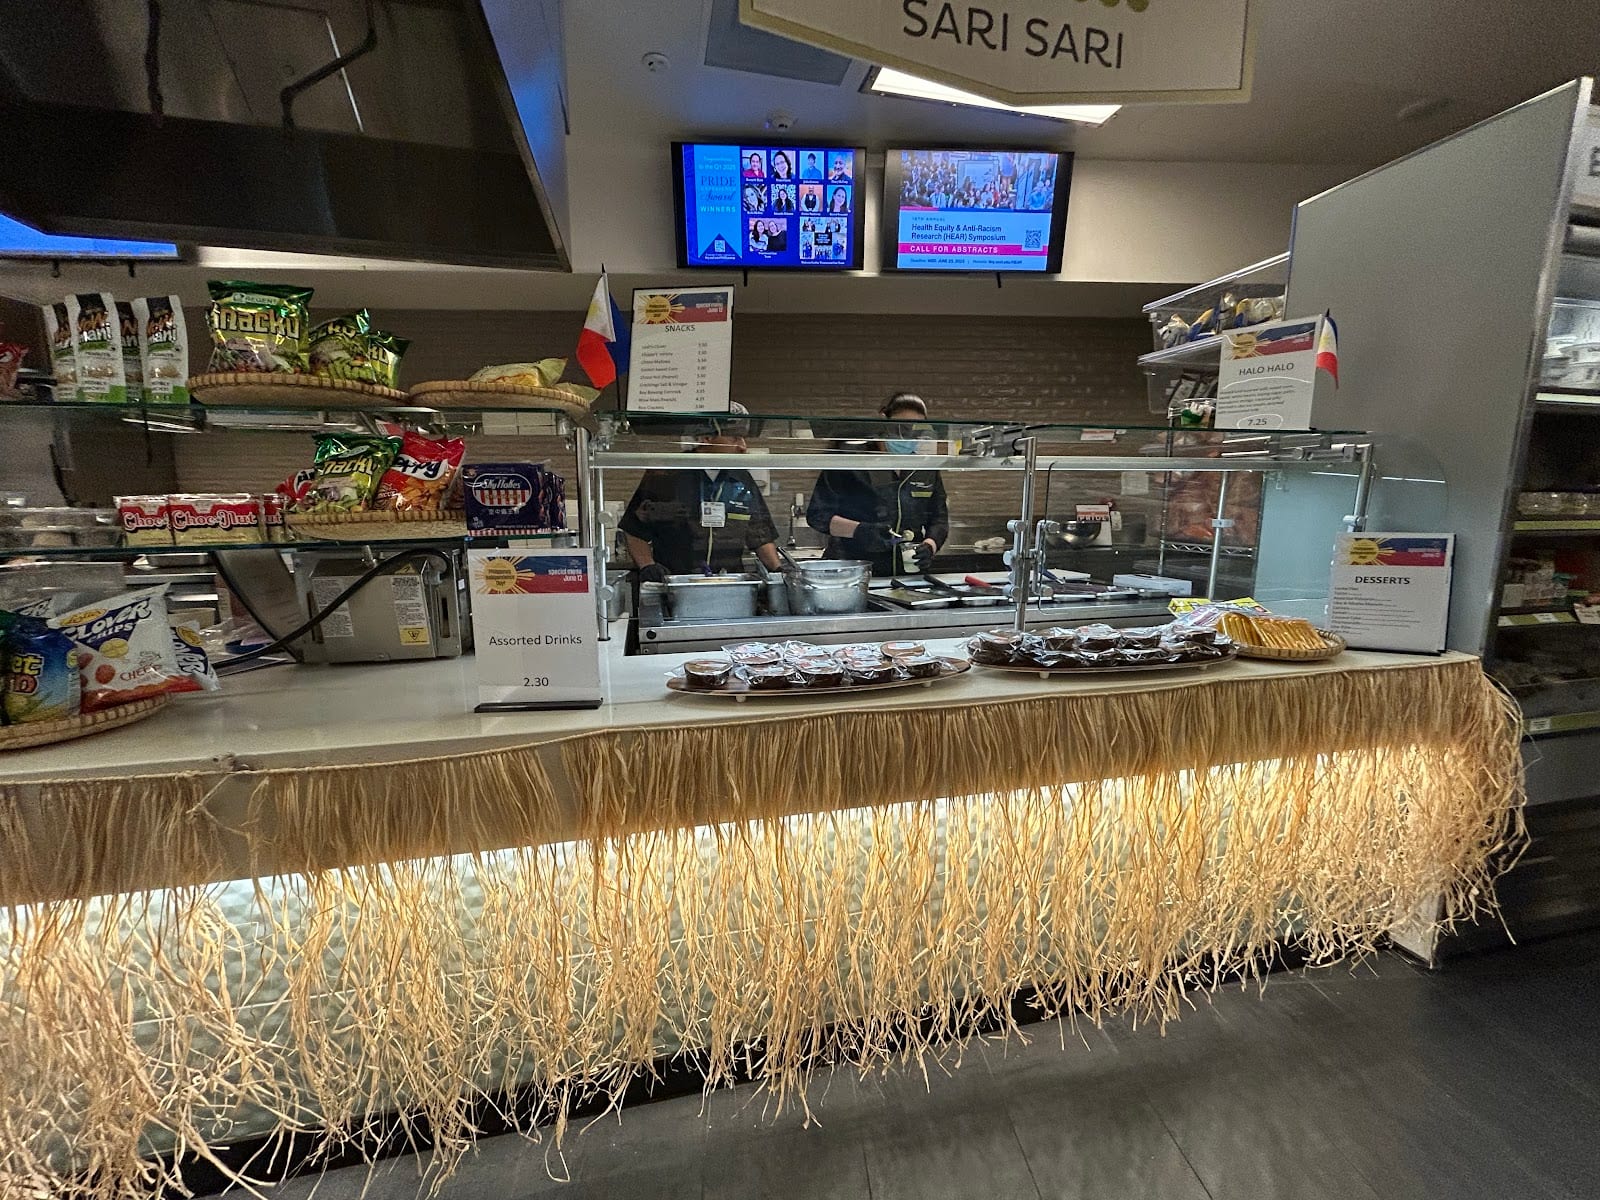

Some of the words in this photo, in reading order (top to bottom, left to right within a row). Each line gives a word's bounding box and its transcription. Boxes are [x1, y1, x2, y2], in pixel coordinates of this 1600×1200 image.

[903, 0, 1009, 52] SARI
[1025, 18, 1124, 69] SARI
[701, 175, 737, 187] PRIDE
[934, 224, 955, 232] Equity
[943, 233, 967, 242] (HEAR)
[969, 234, 1006, 242] Symposium
[952, 246, 998, 254] ABSTRACTS
[665, 324, 696, 333] SNACKS
[1239, 366, 1265, 376] HALO
[1267, 362, 1295, 373] HALO
[1247, 418, 1268, 426] 7.25
[1355, 576, 1410, 585] DESSERTS
[88, 622, 136, 645] CHIPS
[489, 635, 541, 646] Assorted
[545, 634, 582, 645] Drinks
[523, 677, 549, 687] 2.30
